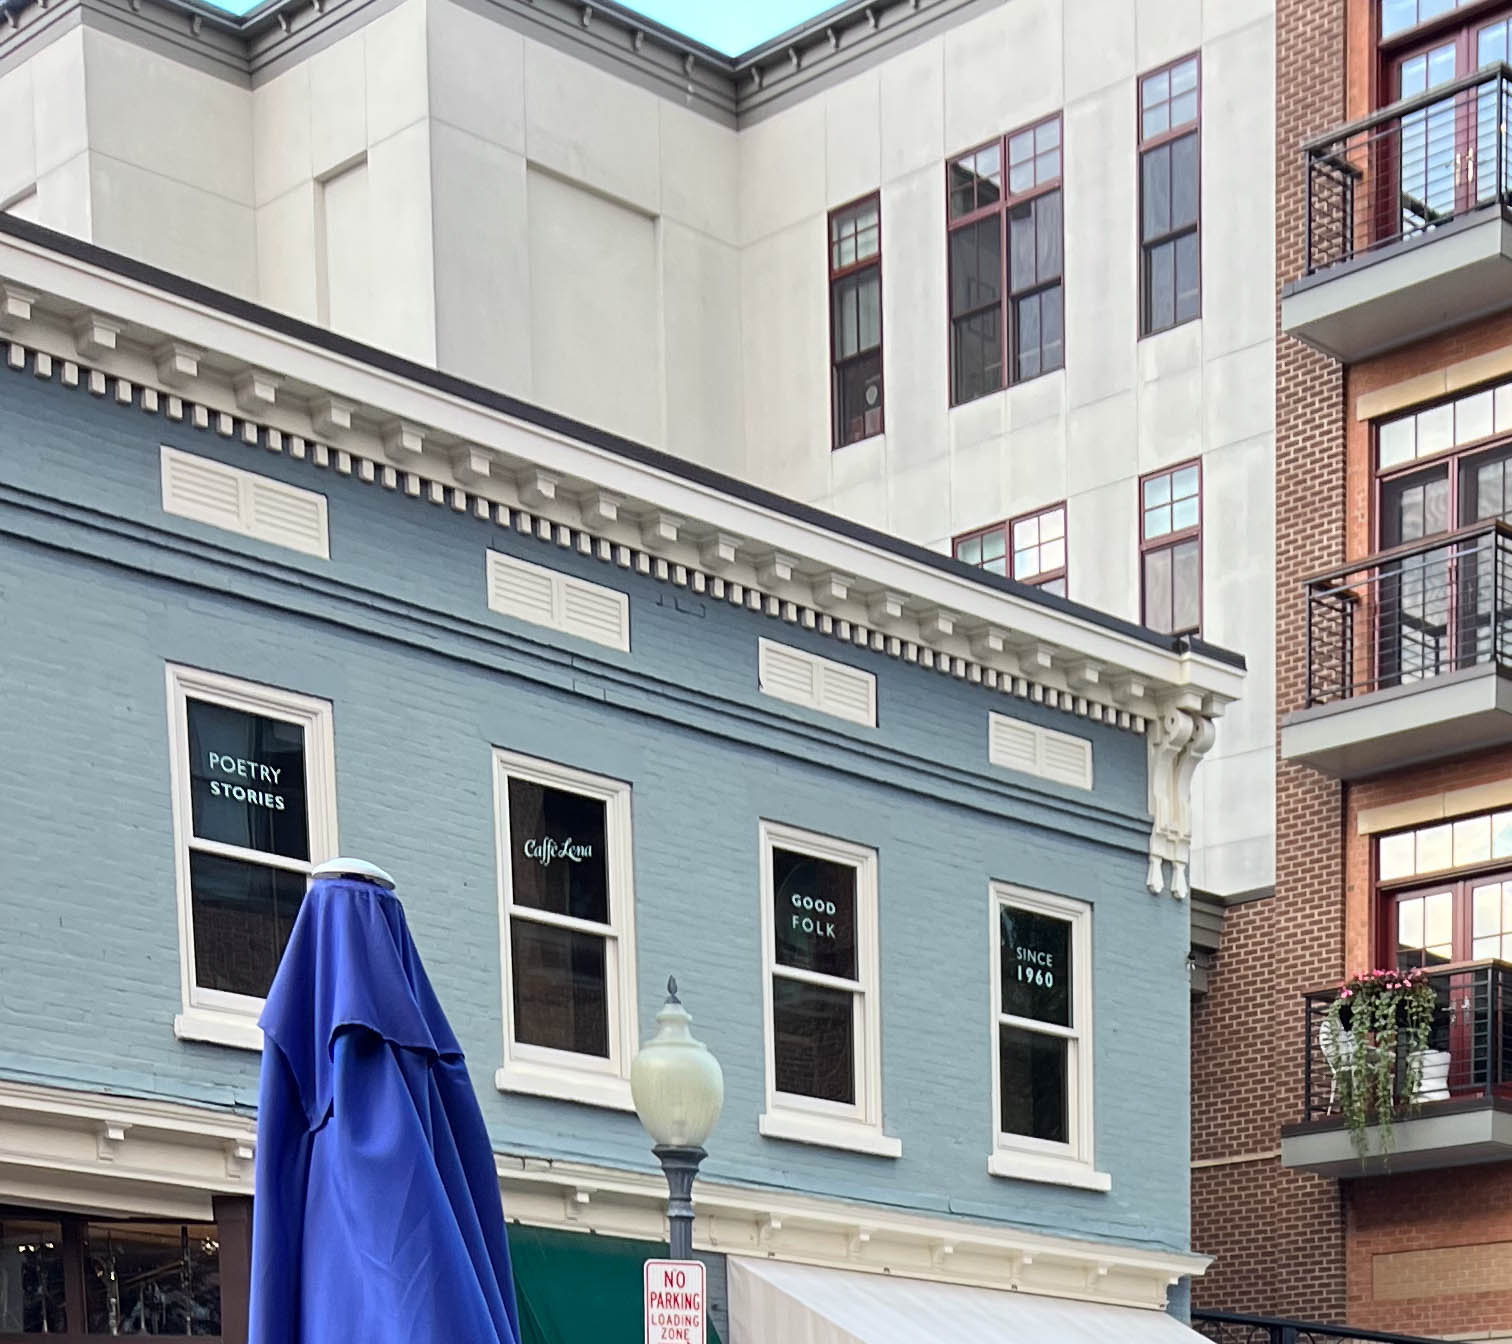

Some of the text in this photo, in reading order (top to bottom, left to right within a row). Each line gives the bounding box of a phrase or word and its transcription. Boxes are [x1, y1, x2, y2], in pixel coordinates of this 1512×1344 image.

[209, 751, 281, 784] POETRY
[210, 781, 285, 810] STORIES
[558, 837, 592, 862] Lena
[792, 894, 836, 915] GOOD
[792, 915, 836, 939] FOLK
[1016, 946, 1053, 968] SINCE
[1017, 964, 1054, 988] 1960
[664, 1271, 686, 1288] NO
[650, 1291, 700, 1310] PARKING
[651, 1313, 700, 1328] LOADING
[661, 1327, 690, 1341] ZONE
